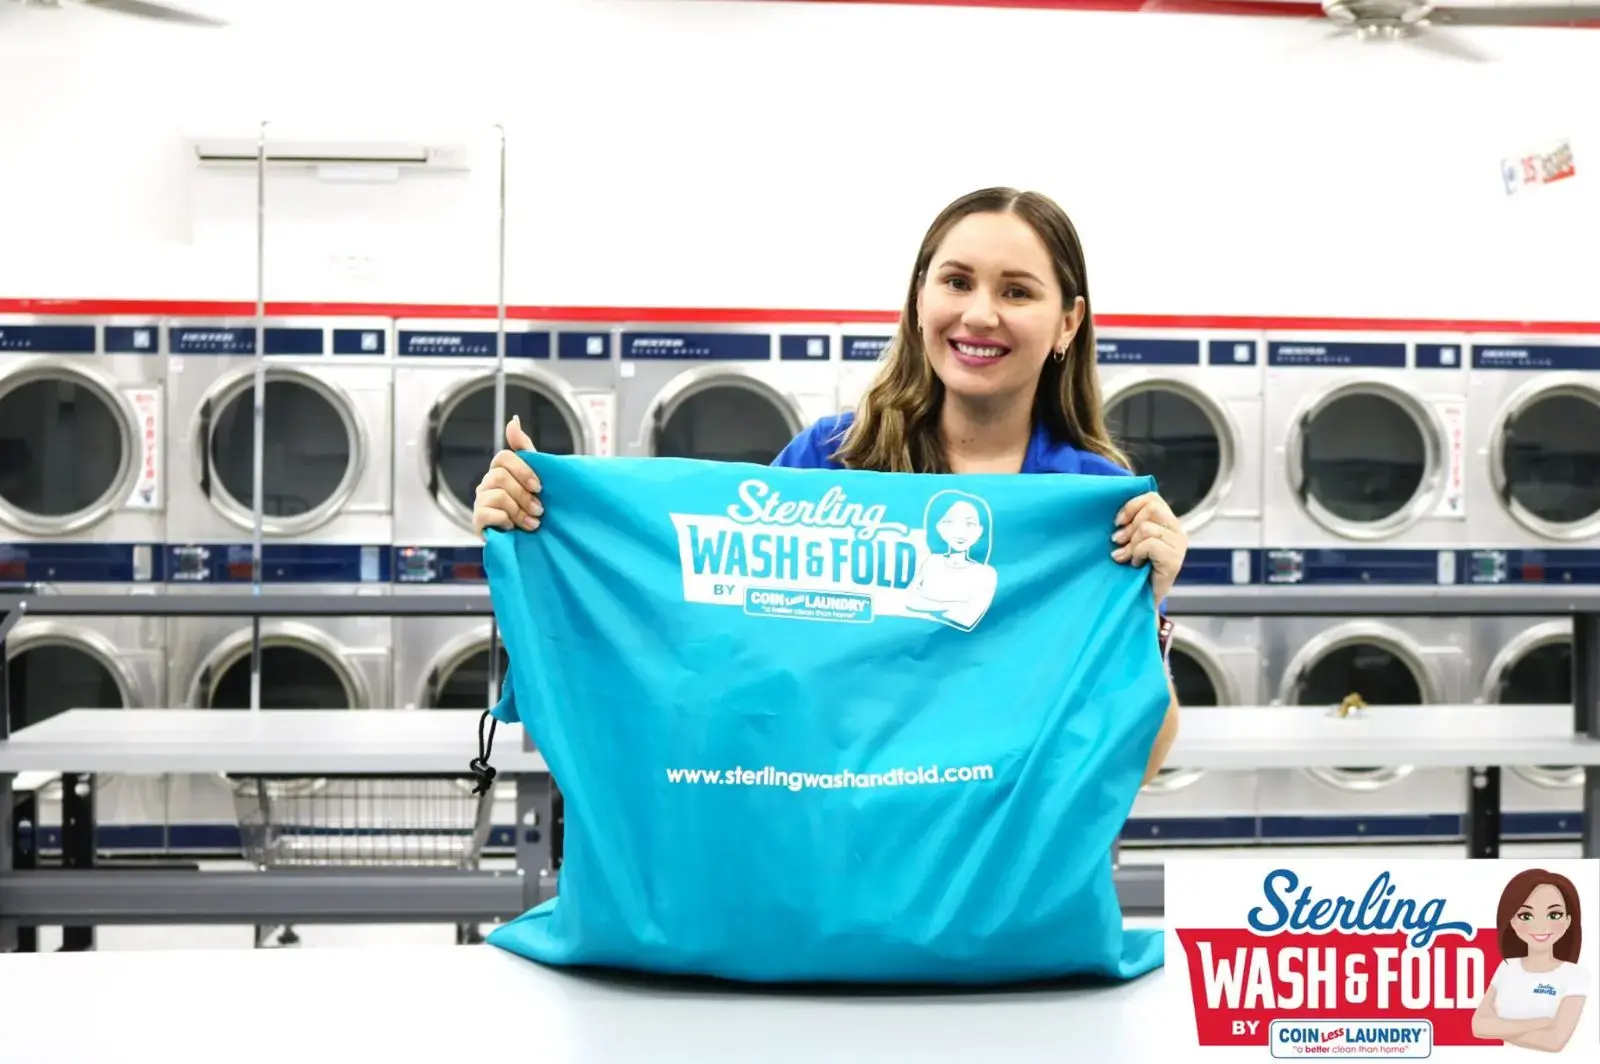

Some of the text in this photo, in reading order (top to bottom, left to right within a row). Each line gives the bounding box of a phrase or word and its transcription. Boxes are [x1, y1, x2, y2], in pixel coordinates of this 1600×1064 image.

[727, 479, 909, 539] Sterling
[687, 524, 917, 590] WASH & FOLD
[713, 584, 736, 596] BY
[751, 592, 785, 606] COIN
[666, 764, 994, 792] www.sterlingwashandfold.com
